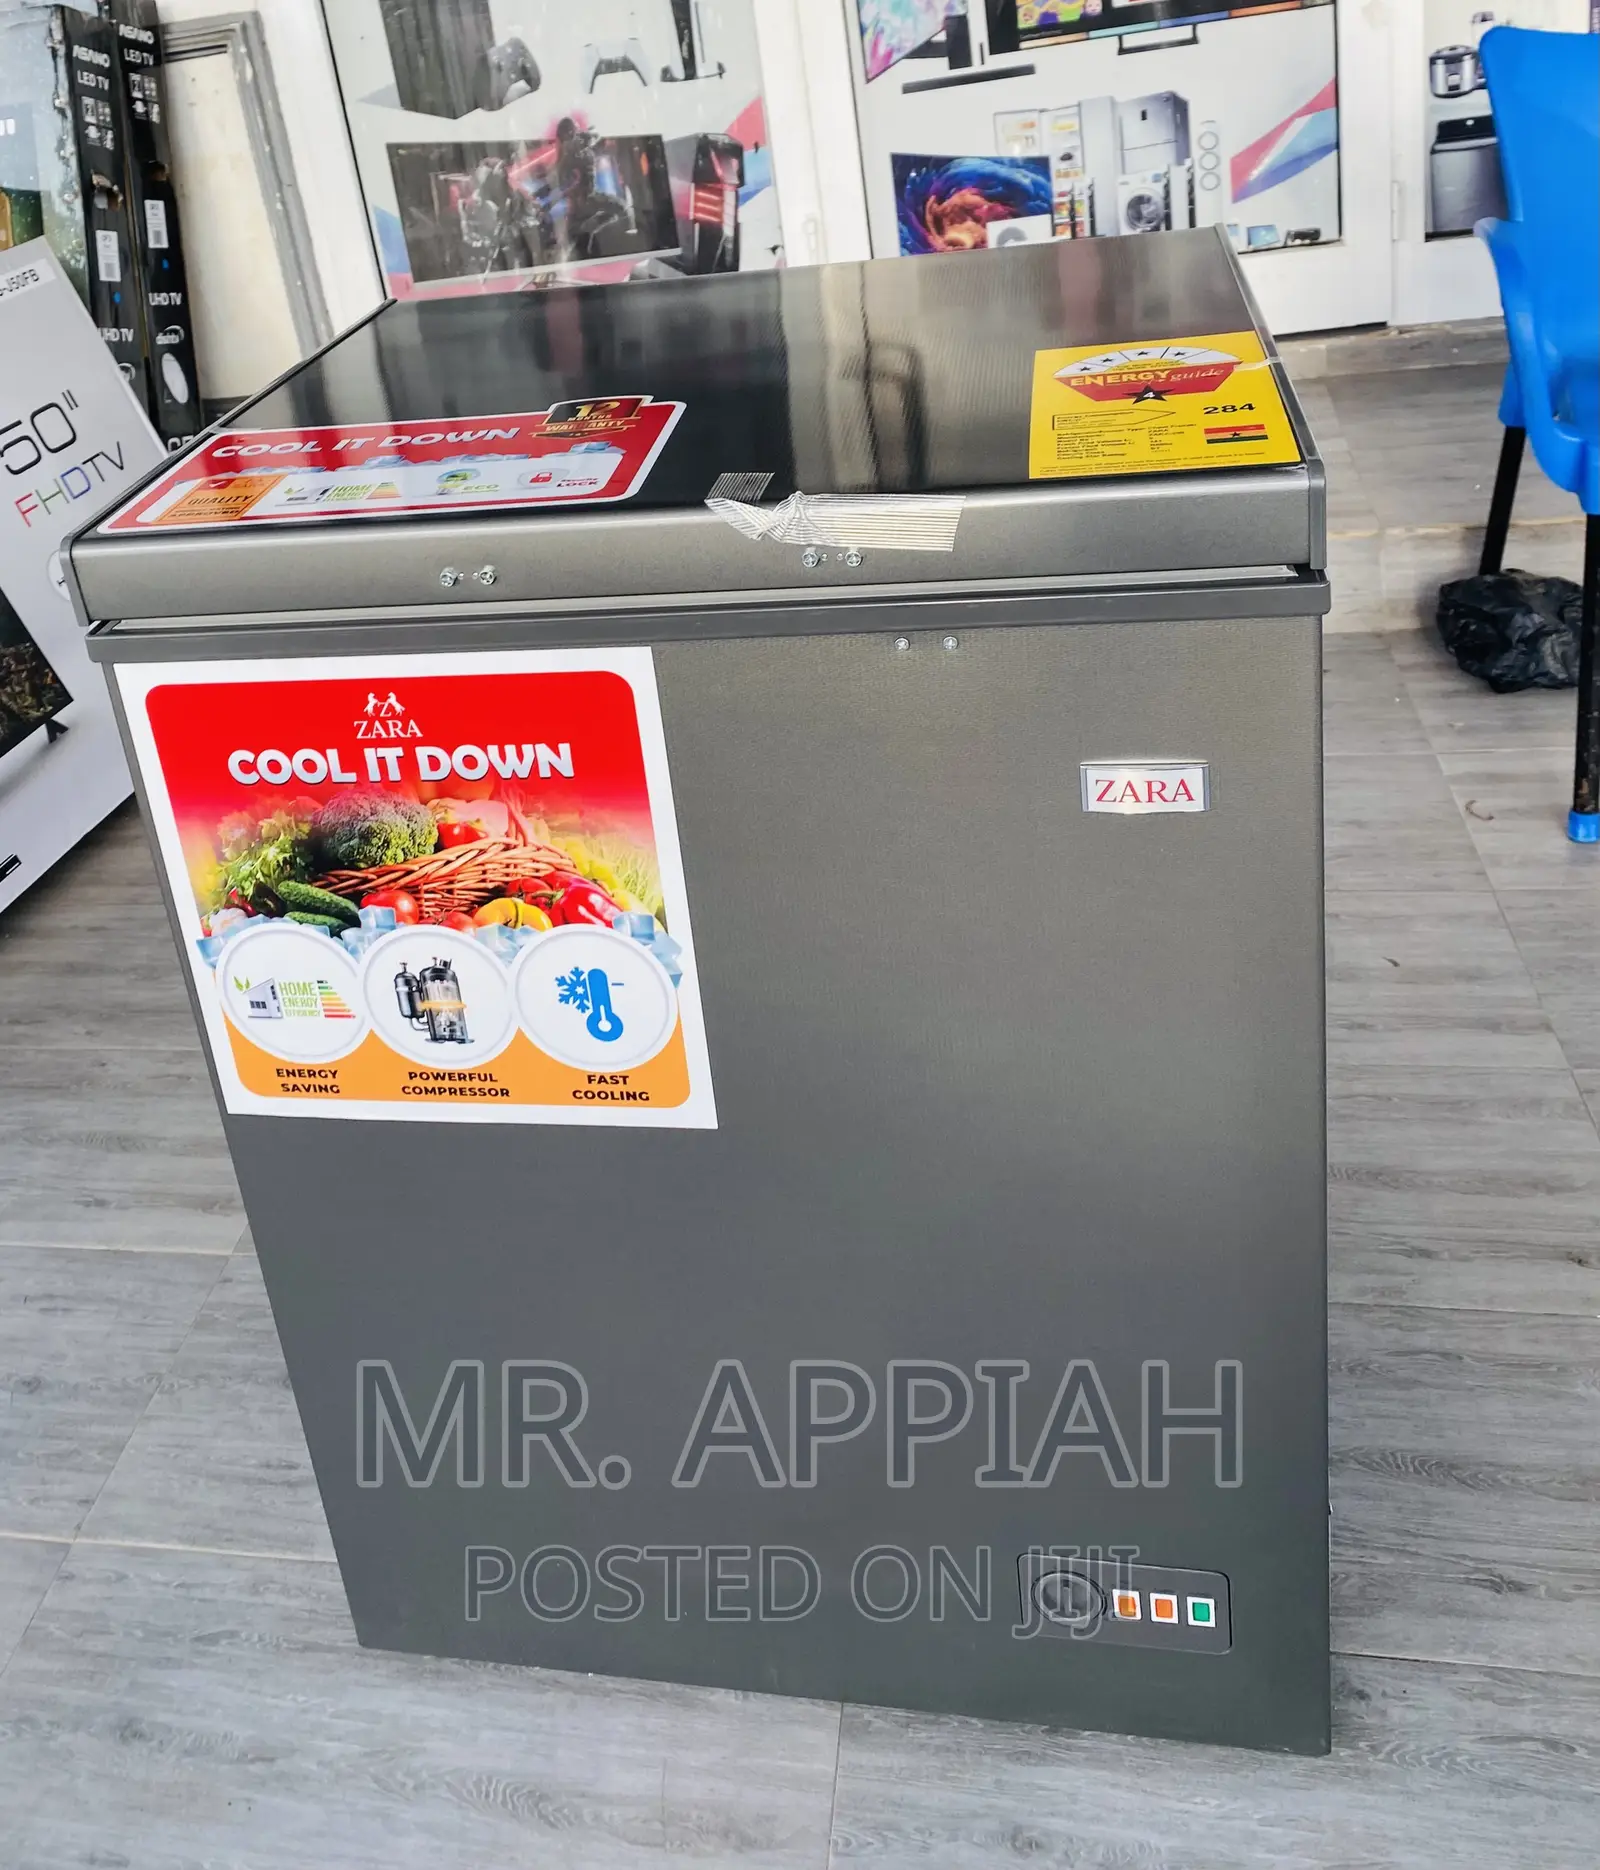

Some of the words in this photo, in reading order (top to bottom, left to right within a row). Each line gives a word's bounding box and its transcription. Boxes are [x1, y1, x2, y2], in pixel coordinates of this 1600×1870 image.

[123, 47, 142, 63] LED
[142, 52, 154, 66] TV
[77, 69, 96, 87] LED
[96, 75, 110, 92] TV
[148, 292, 169, 306] UHD
[170, 292, 182, 306] TV
[120, 328, 134, 342] TV
[1070, 369, 1171, 388] ENERGY
[1169, 367, 1225, 383] guide
[1143, 391, 1156, 399] 4
[575, 401, 621, 418] 12
[1202, 402, 1256, 415] 284
[212, 440, 322, 458] COOL
[331, 436, 376, 451] IT
[377, 427, 521, 449] DOWN
[15, 441, 125, 528] FHDTV
[188, 494, 254, 505] QUALITY
[353, 718, 424, 740] ZARA
[227, 748, 358, 785] COOL
[363, 746, 405, 783] IT
[414, 742, 575, 782] DOWN
[1094, 778, 1197, 804] ZARA
[278, 981, 317, 996] HOME
[282, 996, 318, 1009] ENERGY
[276, 1068, 338, 1079] ENERGY
[408, 1071, 499, 1083] POWERFUL
[587, 1074, 630, 1086] FAST
[280, 1083, 340, 1094] SAVING
[401, 1085, 511, 1099] COMPRESSOR
[572, 1089, 650, 1102] COOLING
